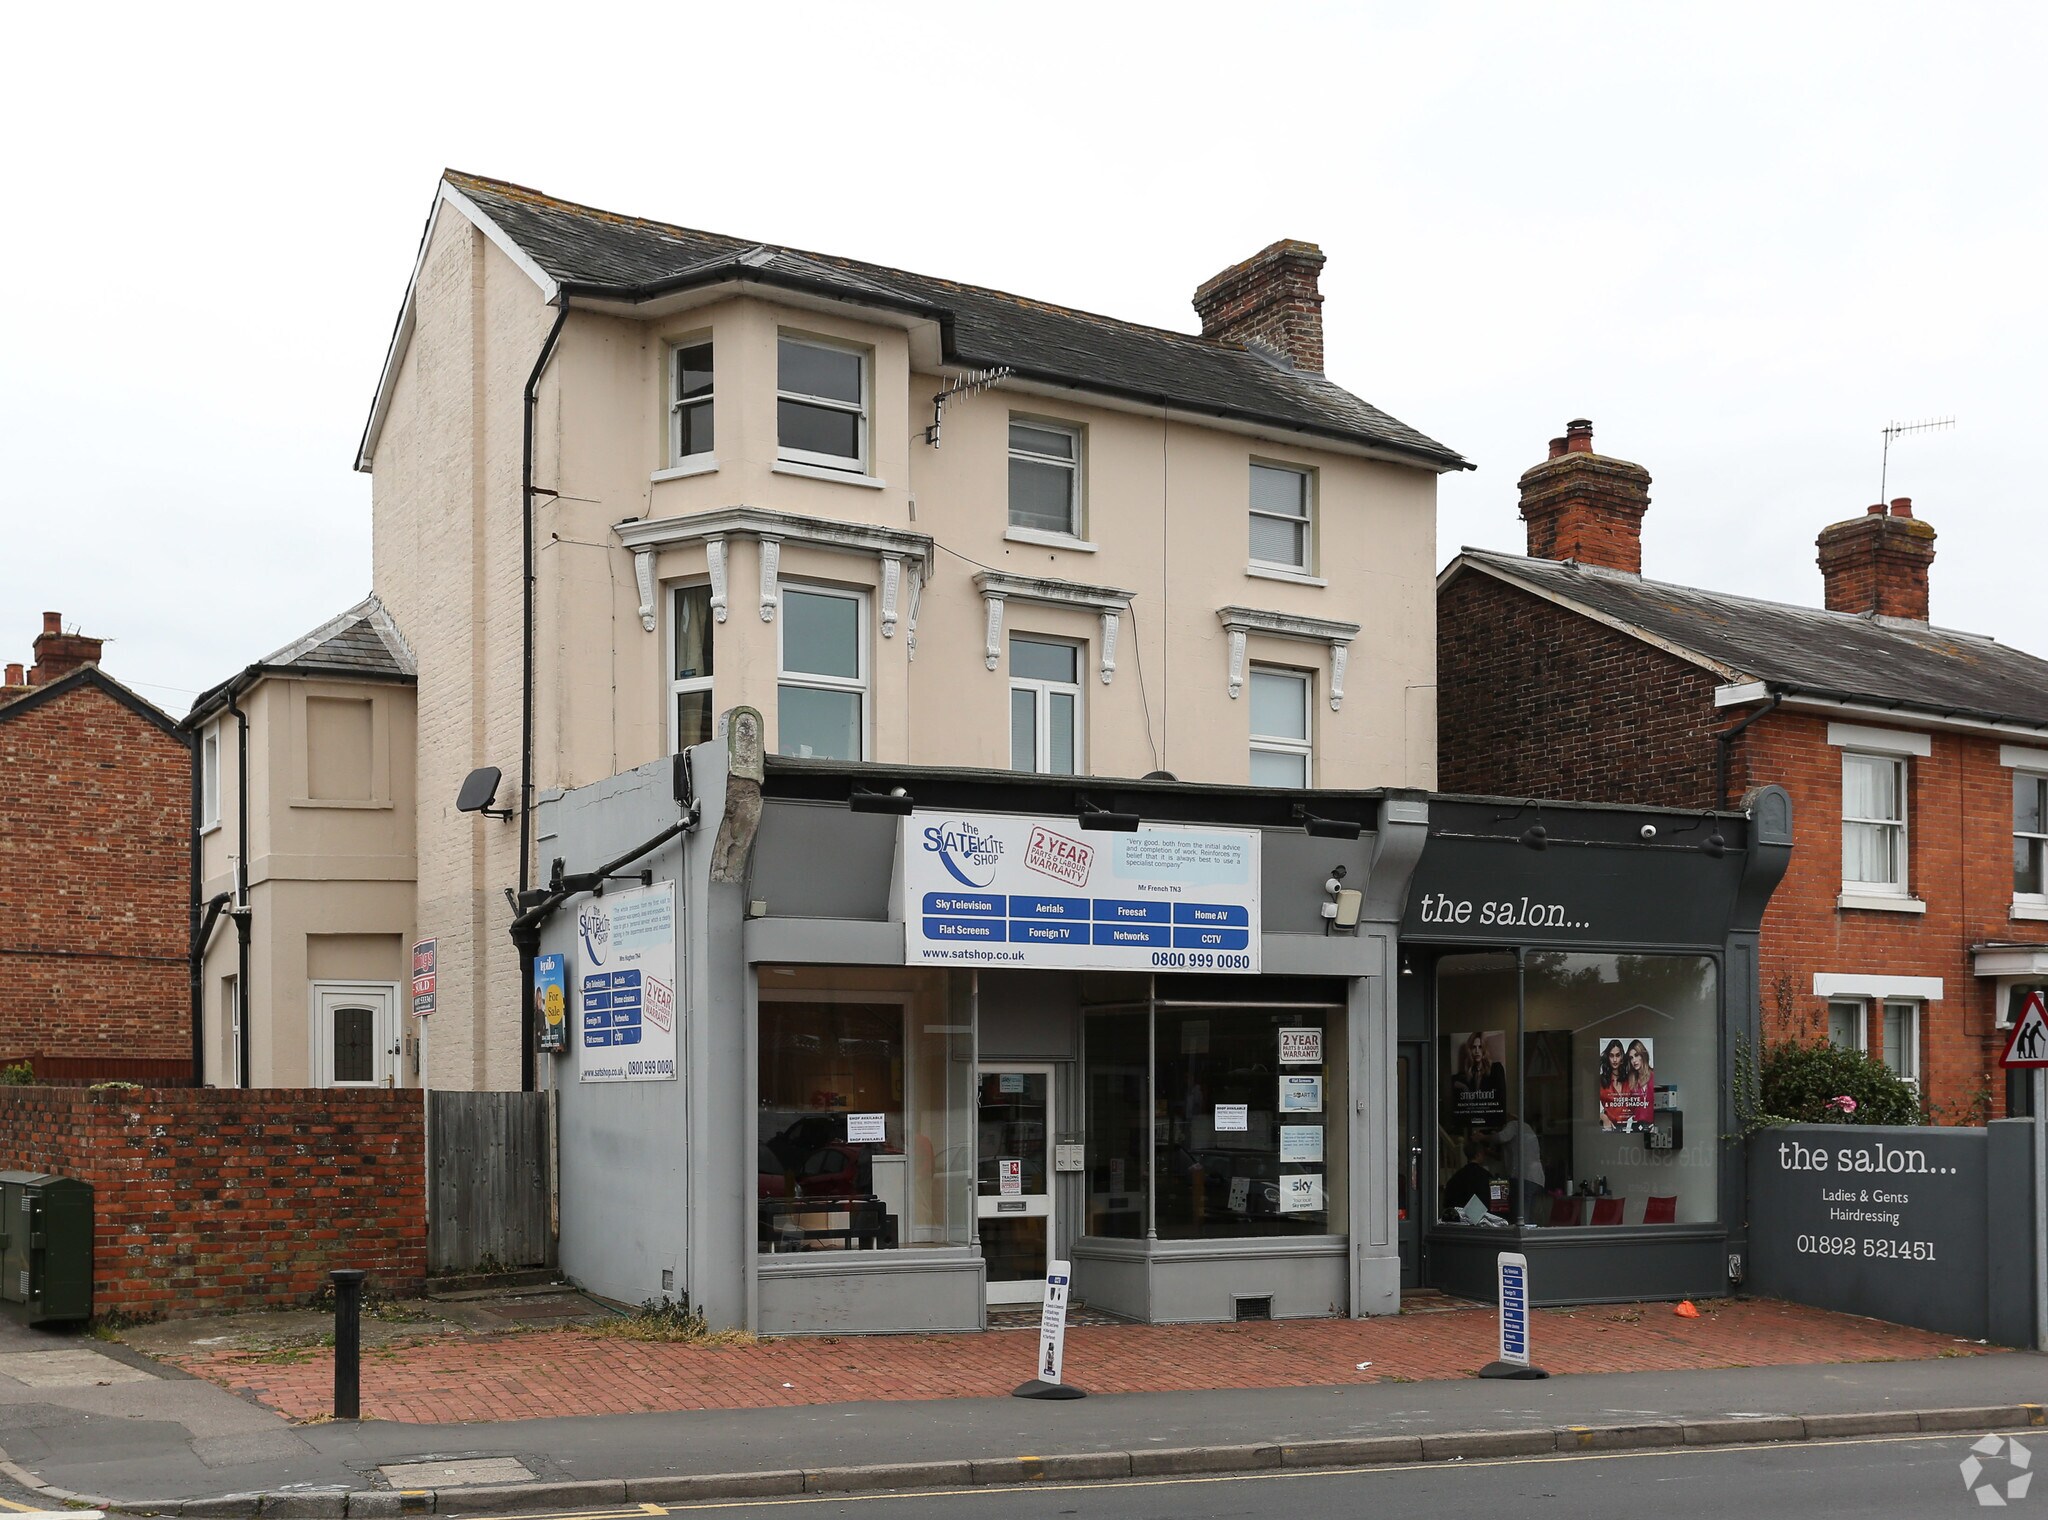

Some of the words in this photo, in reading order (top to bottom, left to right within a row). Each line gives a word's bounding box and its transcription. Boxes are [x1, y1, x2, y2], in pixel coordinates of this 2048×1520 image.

[962, 821, 979, 835] the
[923, 827, 1005, 854] SATELLITE
[1193, 841, 1203, 849] the
[1204, 842, 1220, 850] initial
[1222, 843, 1241, 851] advice
[1034, 832, 1045, 849] 2
[1049, 837, 1089, 866] YEAR
[1139, 846, 1172, 854] completion
[1200, 849, 1230, 857] Reinforces
[973, 854, 999, 866] SHOP
[1031, 847, 1052, 860] PARTS
[1059, 858, 1086, 873] LABOUR
[1126, 859, 1154, 867] specialist
[1176, 855, 1196, 863] always
[1030, 854, 1084, 882] WARRANTY
[1137, 884, 1147, 892] Mr
[1147, 884, 1169, 893] French
[1169, 885, 1182, 893] TN3
[935, 899, 951, 911] Sky
[951, 899, 992, 911] Television
[1035, 903, 1065, 914] Aerials
[1420, 893, 1473, 924] the
[1479, 897, 1590, 929] salon...
[1117, 906, 1147, 917] Freesat
[1194, 910, 1216, 920] Home
[1216, 911, 1228, 921] AV
[939, 924, 956, 935] Flat
[957, 925, 990, 936] Screens
[1028, 927, 1059, 940] Foreign
[1059, 929, 1070, 939] TV
[1113, 930, 1150, 942] Networks
[1201, 934, 1222, 944] CCTV
[922, 949, 1025, 962] www.satshop.co.uk
[1151, 952, 1186, 968] 0800
[1188, 953, 1214, 968] 999
[1217, 954, 1250, 969] 0080
[548, 991, 559, 1002] For
[647, 981, 653, 998] 2
[653, 985, 672, 1010] YEAR
[547, 1005, 560, 1017] Sale
[645, 1003, 670, 1027] WARRANTY
[1283, 1034, 1290, 1046] 2
[1291, 1034, 1319, 1046] YEAR
[1283, 1050, 1319, 1058] WARRANTY
[628, 1060, 644, 1075] 0800
[644, 1060, 656, 1075] 999
[657, 1059, 674, 1074] 0080
[1778, 1141, 1829, 1172] the
[1837, 1143, 1957, 1175] salon...
[1292, 1178, 1313, 1194] sky
[1822, 1188, 1857, 1202] Ladies
[1859, 1189, 1869, 1202] &
[1872, 1189, 1909, 1204] Gents
[1829, 1207, 1900, 1227] Hairdressing
[1796, 1234, 1857, 1256] 01892
[1863, 1238, 1937, 1261] 521451
